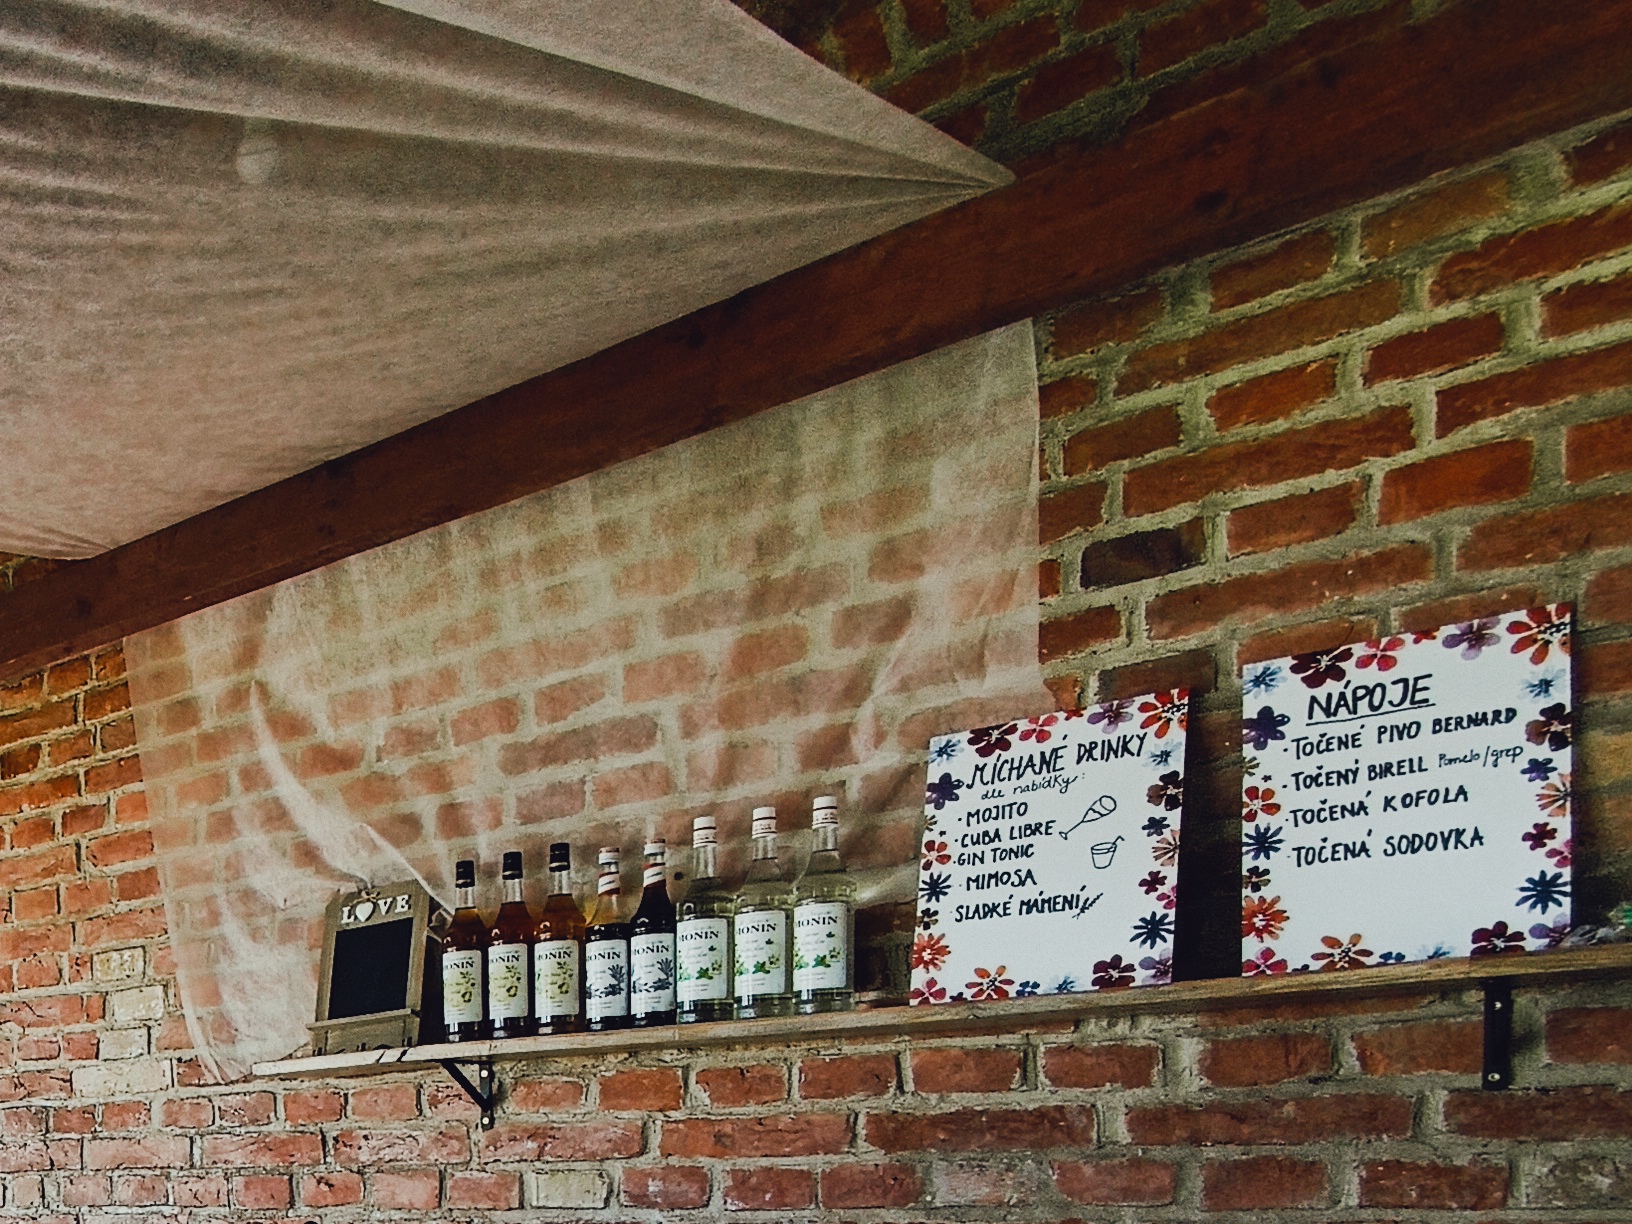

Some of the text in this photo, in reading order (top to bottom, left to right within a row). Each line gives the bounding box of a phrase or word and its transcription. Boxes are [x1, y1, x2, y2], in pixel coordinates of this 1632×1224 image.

[1307, 673, 1433, 720] NÁPOJE
[1290, 707, 1518, 760] TOČENÉ PIVO BERNARD
[965, 732, 1147, 790] MÍCHANÉ DRINKY
[1290, 759, 1360, 791] TOČENÝ
[1367, 756, 1429, 781] BIRELL
[967, 801, 1028, 827] MOJITO
[1289, 785, 1469, 828] TOČENÁ KOFOLA
[961, 819, 1057, 848] CUBA LIBRE
[1291, 826, 1485, 868] TOČENÁ SODOVKA
[957, 844, 1035, 866] GIN TONIC
[966, 868, 1037, 891] MIMOSA
[954, 885, 1086, 922] SLADKÉ MÁMENÍ
[587, 951, 622, 961] ONIN
